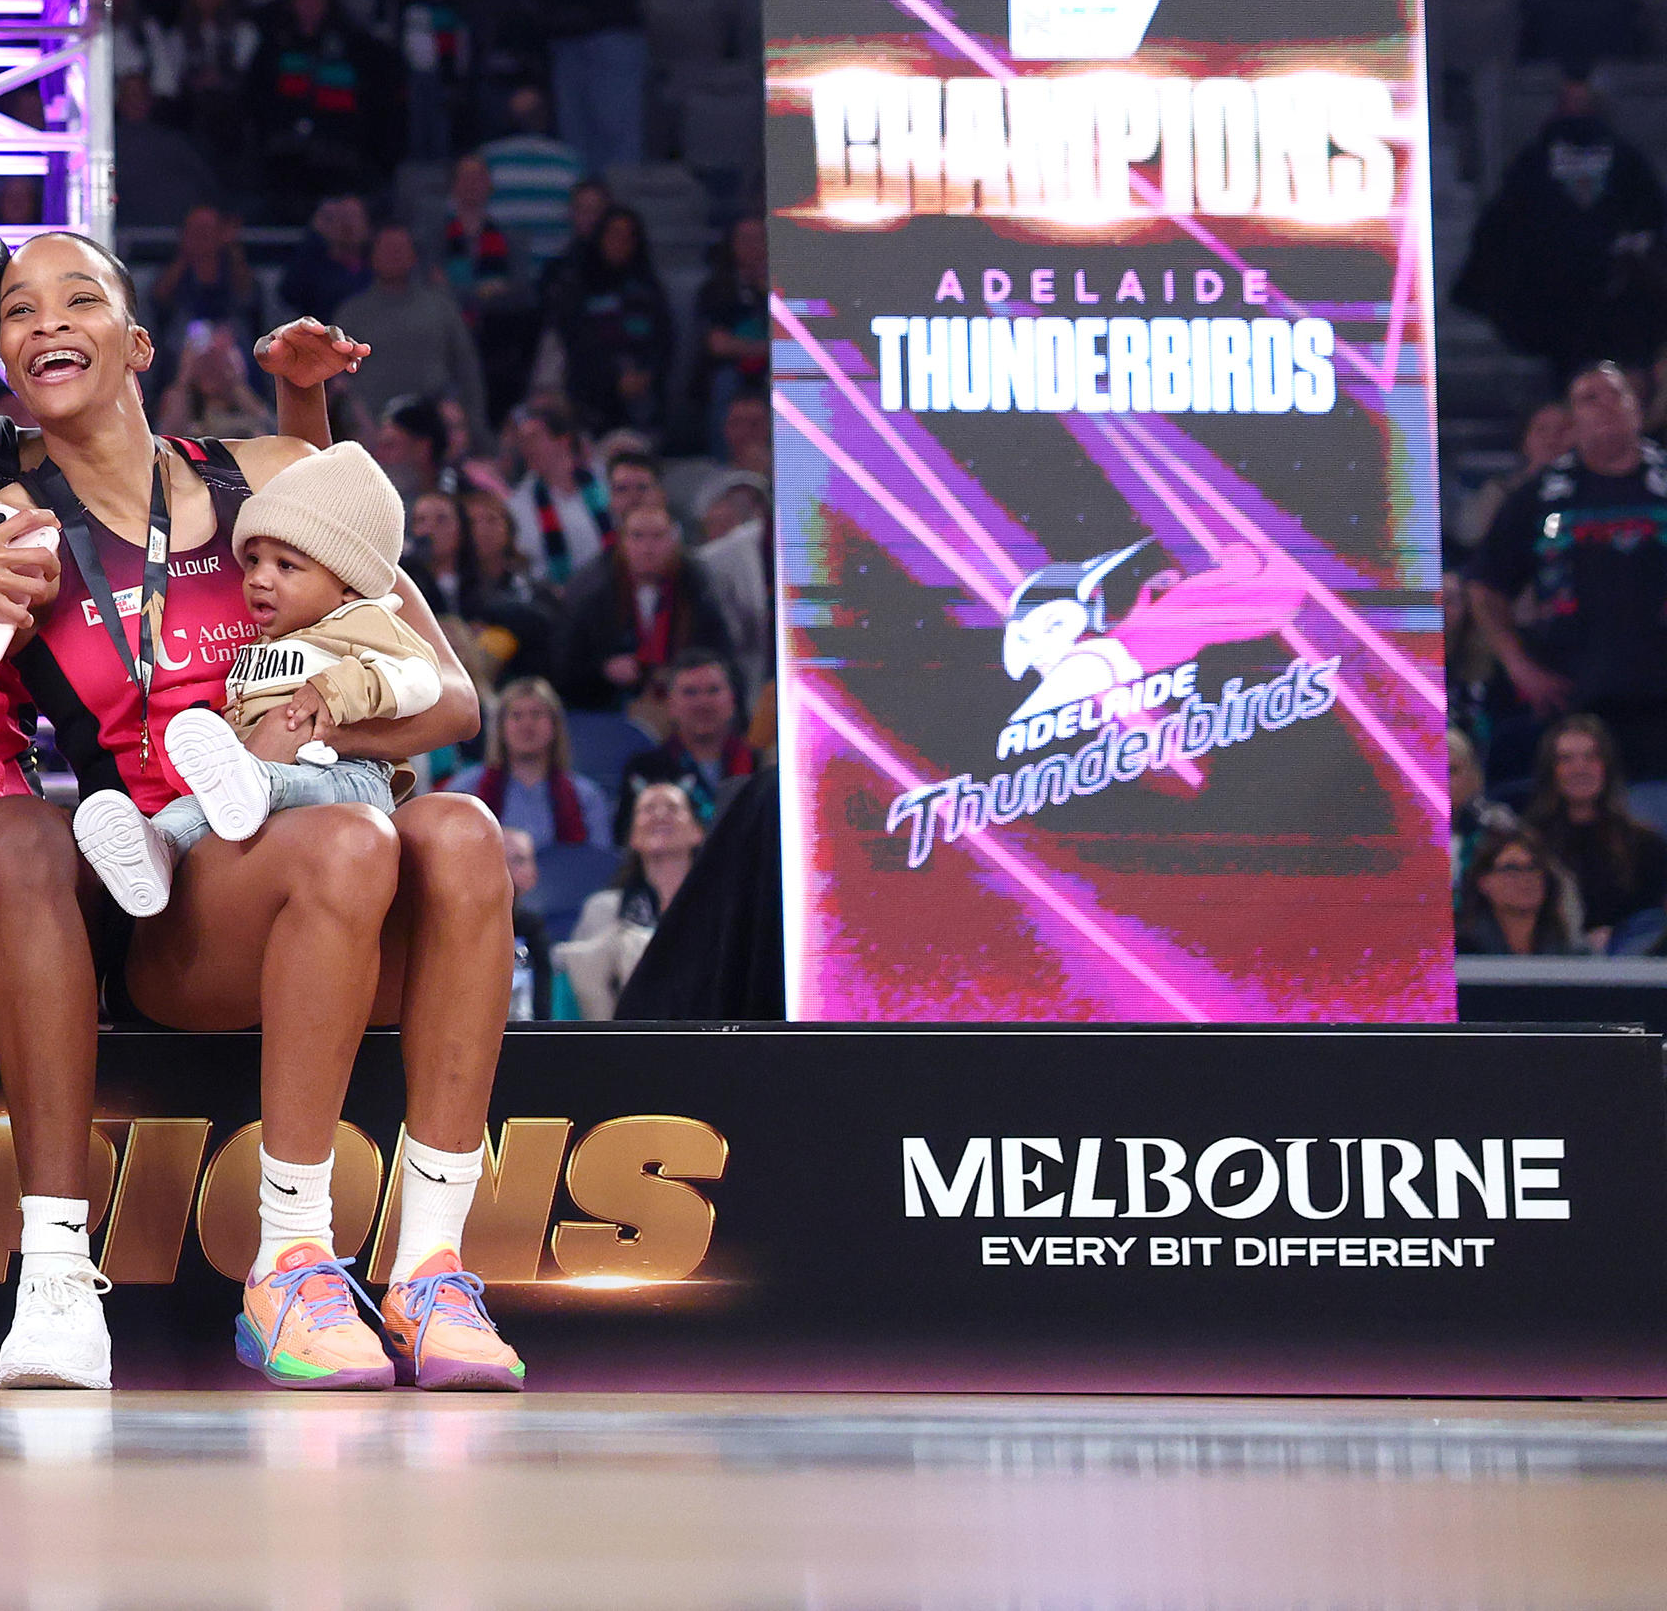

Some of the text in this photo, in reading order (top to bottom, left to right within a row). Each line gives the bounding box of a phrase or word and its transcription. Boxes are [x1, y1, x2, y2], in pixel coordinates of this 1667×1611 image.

[814, 74, 1395, 216] CHAMPIONS
[935, 270, 1271, 305] ADELAIDE
[871, 317, 1336, 414] THUNDERBIRDS
[997, 663, 1199, 759] ADELAIDE
[887, 656, 1342, 868] Thunderbirds
[903, 1137, 1570, 1220] MELBOURNE
[981, 1237, 1494, 1266] EVERY BIT DIFFERENT
